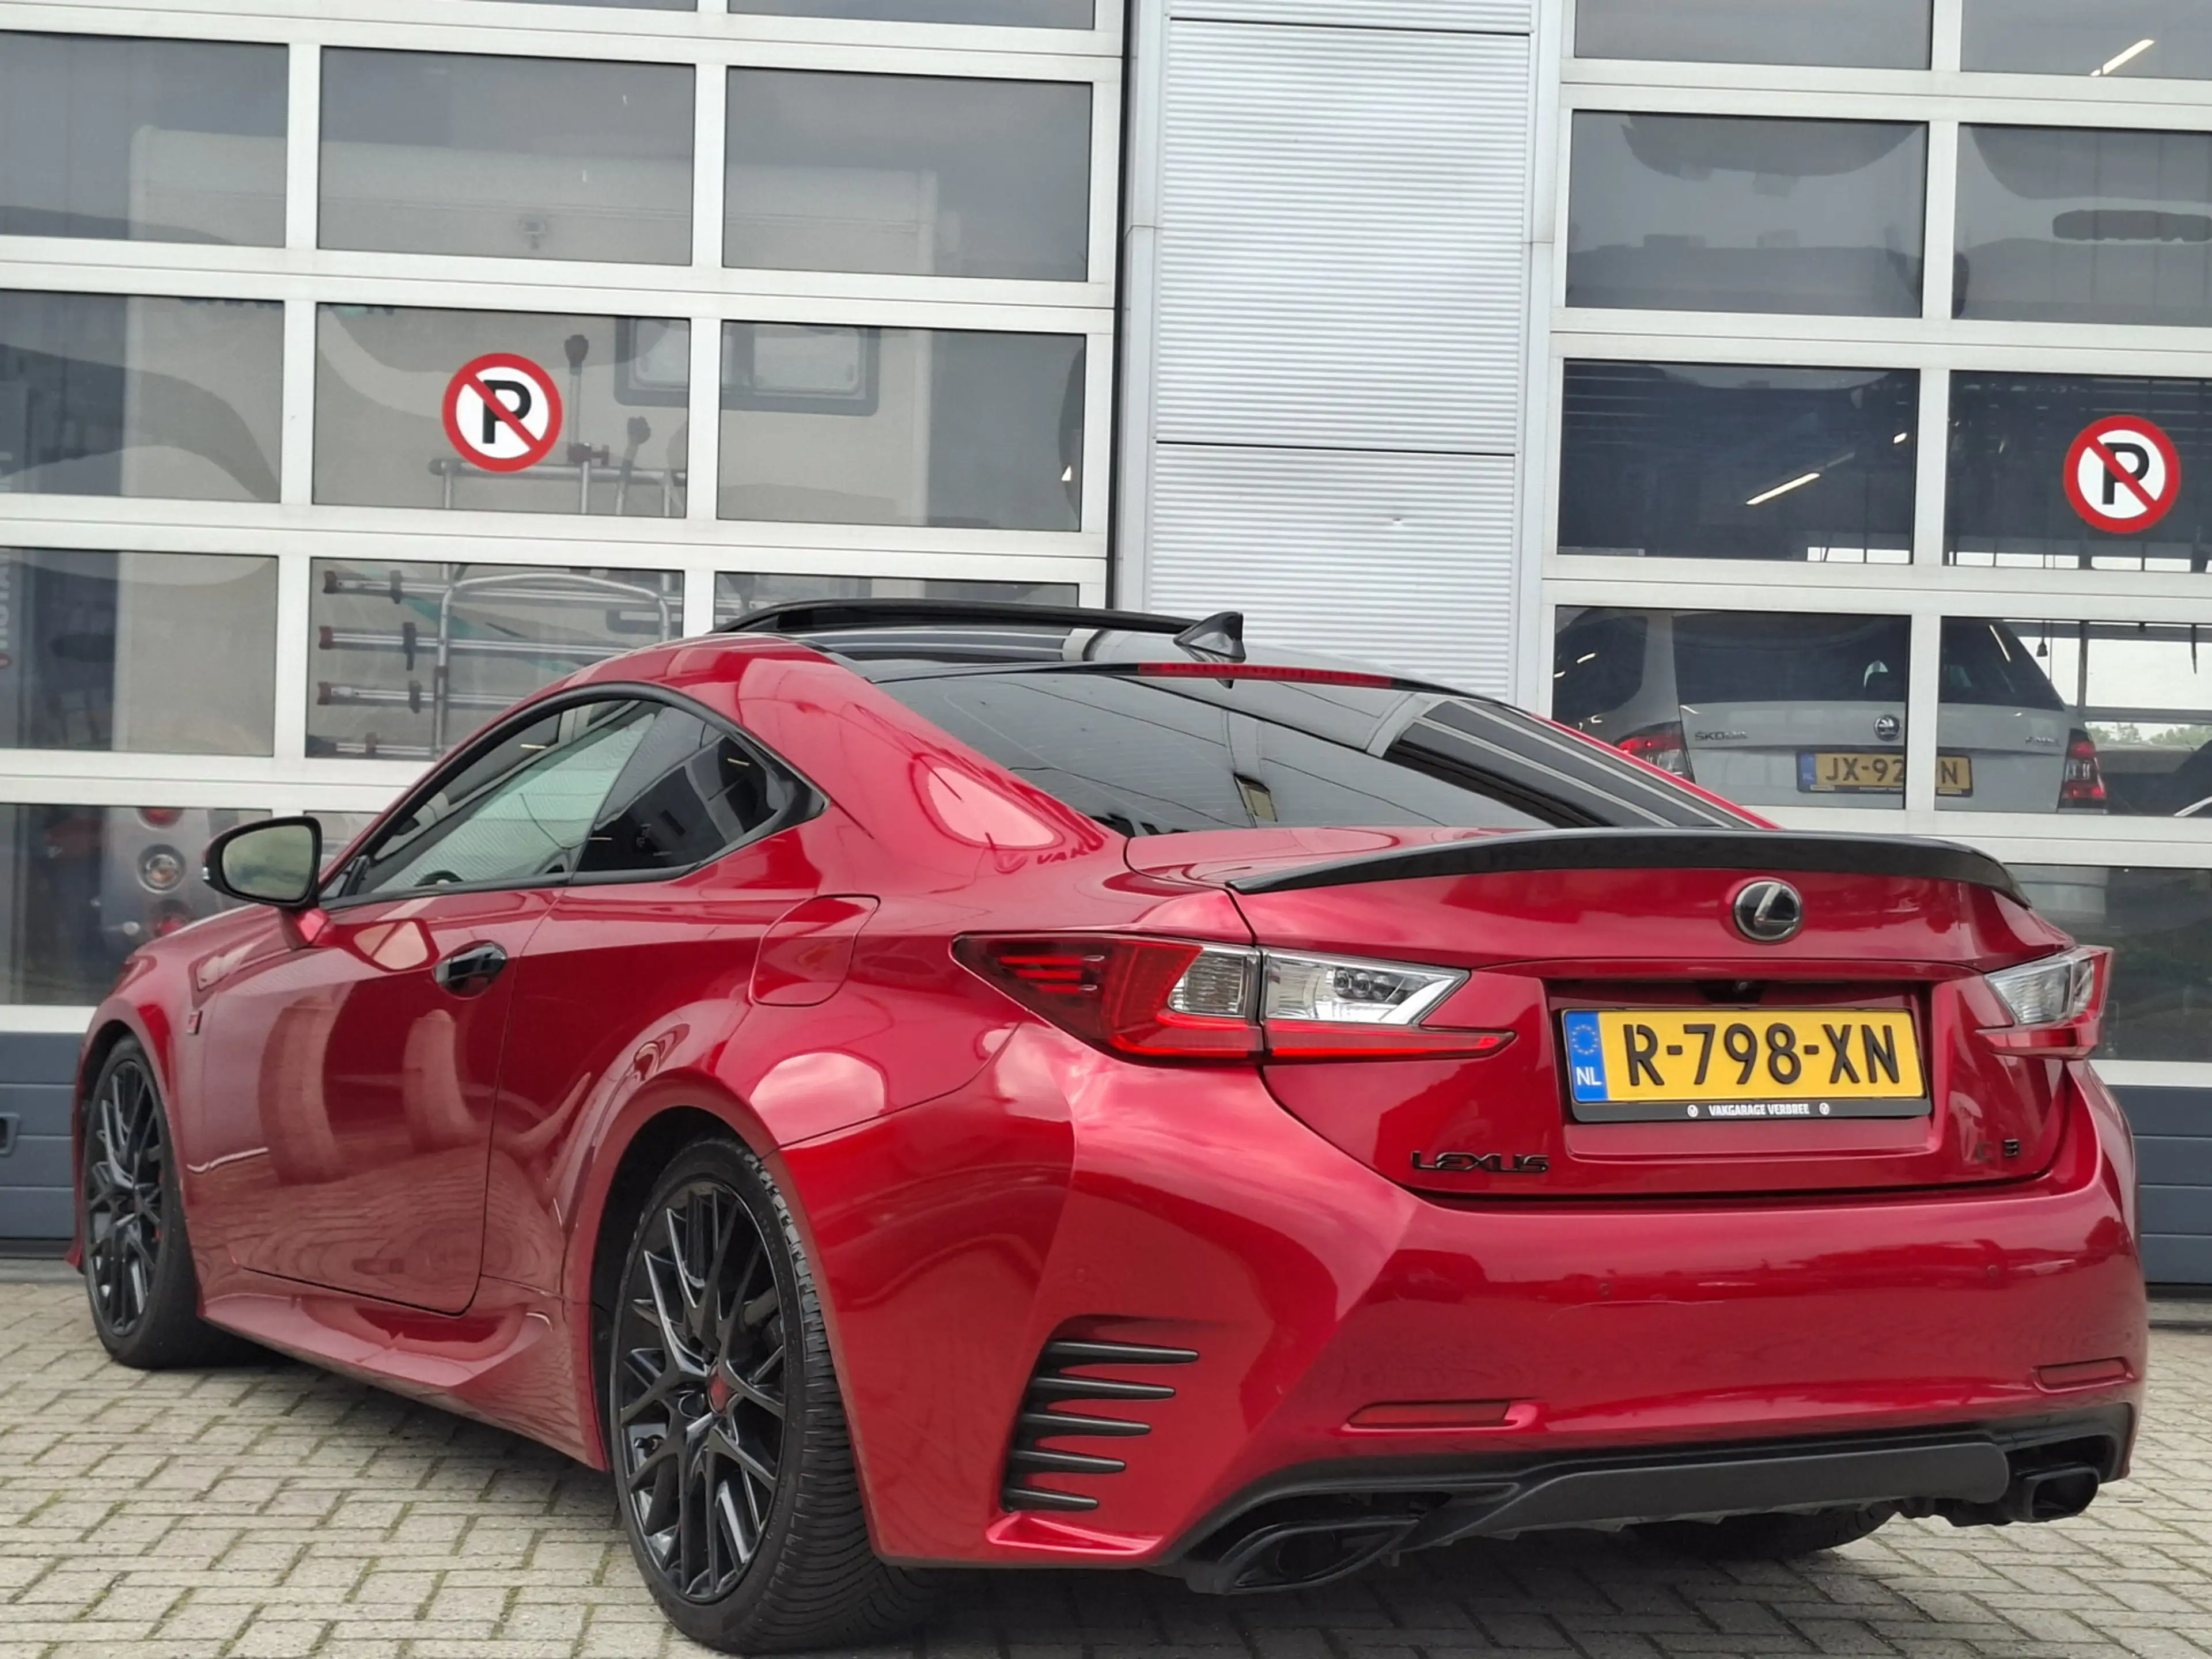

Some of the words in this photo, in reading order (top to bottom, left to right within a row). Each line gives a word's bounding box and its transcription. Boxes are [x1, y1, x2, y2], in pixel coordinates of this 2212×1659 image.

[1623, 1022, 1900, 1086] R-798-XN
[1576, 1067, 1603, 1086] NL
[1708, 1104, 1766, 1116] VAKGARAGE
[1411, 1150, 1549, 1173] LEXUS
